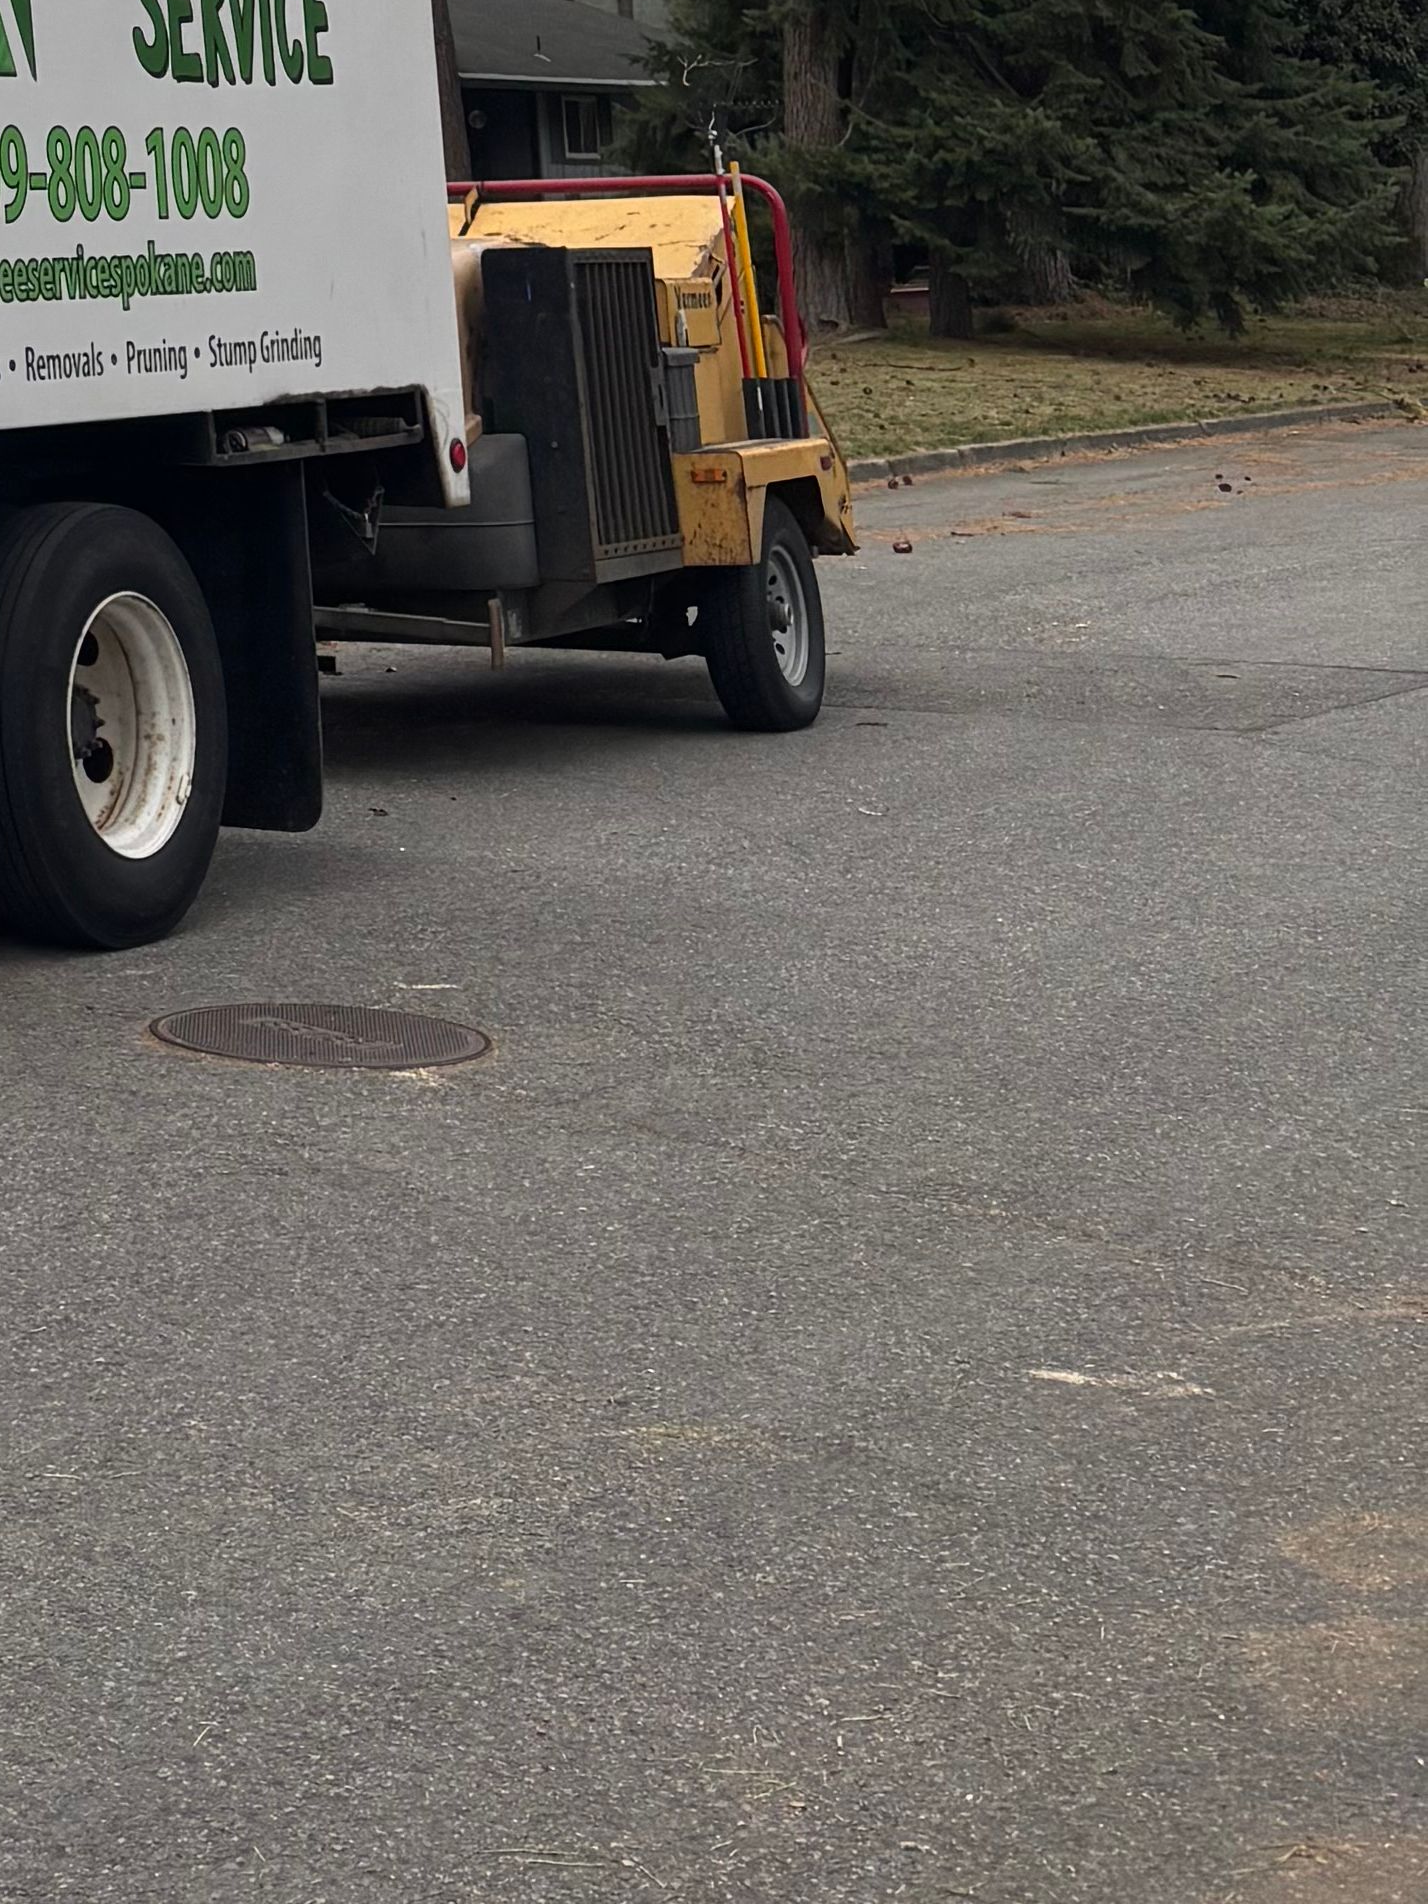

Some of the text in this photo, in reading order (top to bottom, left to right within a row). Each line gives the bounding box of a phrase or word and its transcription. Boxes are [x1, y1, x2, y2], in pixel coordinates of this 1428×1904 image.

[25, 341, 104, 382] Removals
[126, 339, 188, 380] Pruning
[208, 335, 257, 373] Stump
[260, 327, 322, 367] Grinding
